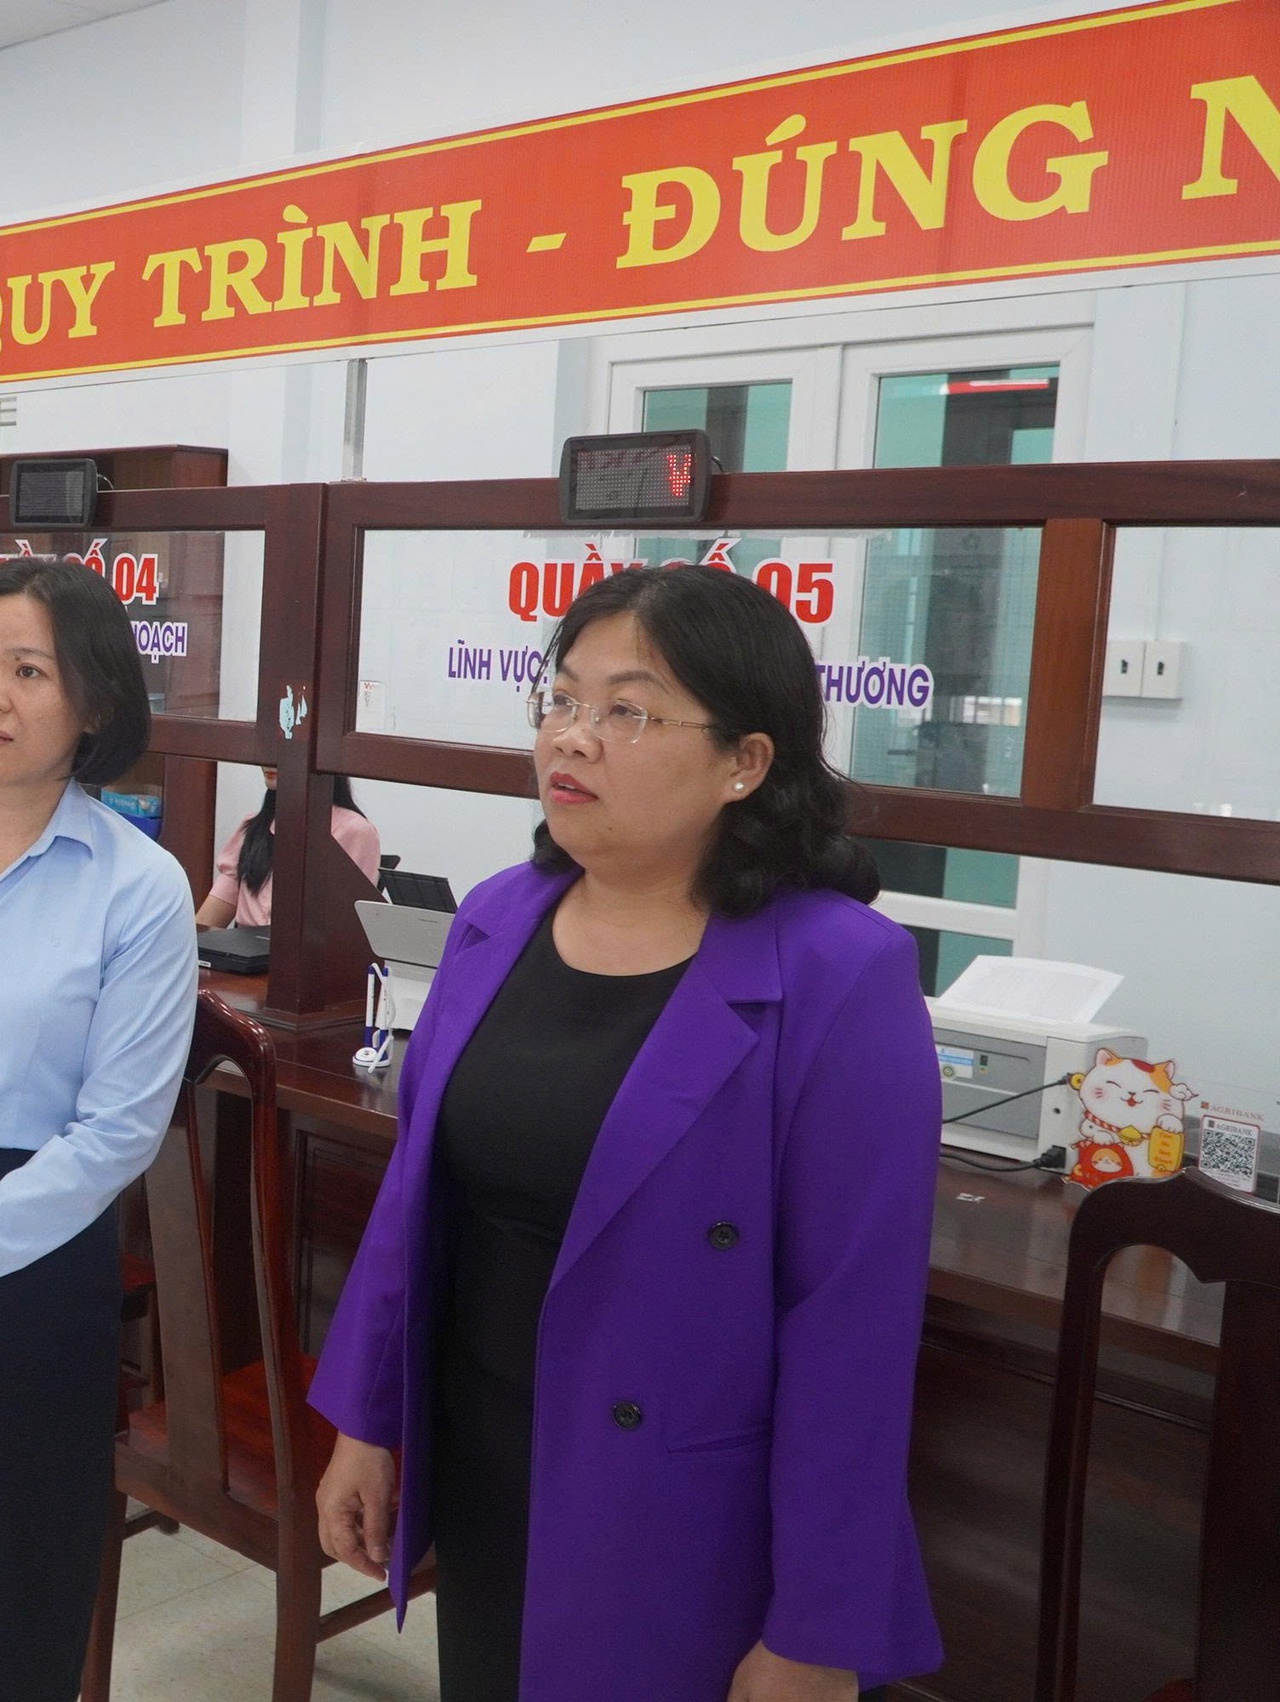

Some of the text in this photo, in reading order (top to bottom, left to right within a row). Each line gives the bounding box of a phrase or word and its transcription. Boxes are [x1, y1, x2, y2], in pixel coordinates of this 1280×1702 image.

[141, 204, 482, 328] TRÌNH
[526, 232, 567, 253] -
[615, 100, 1109, 269] ĐÚNG
[114, 555, 158, 603] 04
[508, 543, 643, 622] QUẦ
[757, 560, 835, 624] 05
[448, 639, 492, 681] LĨNH
[1210, 1104, 1265, 1121] AGRIBANK
